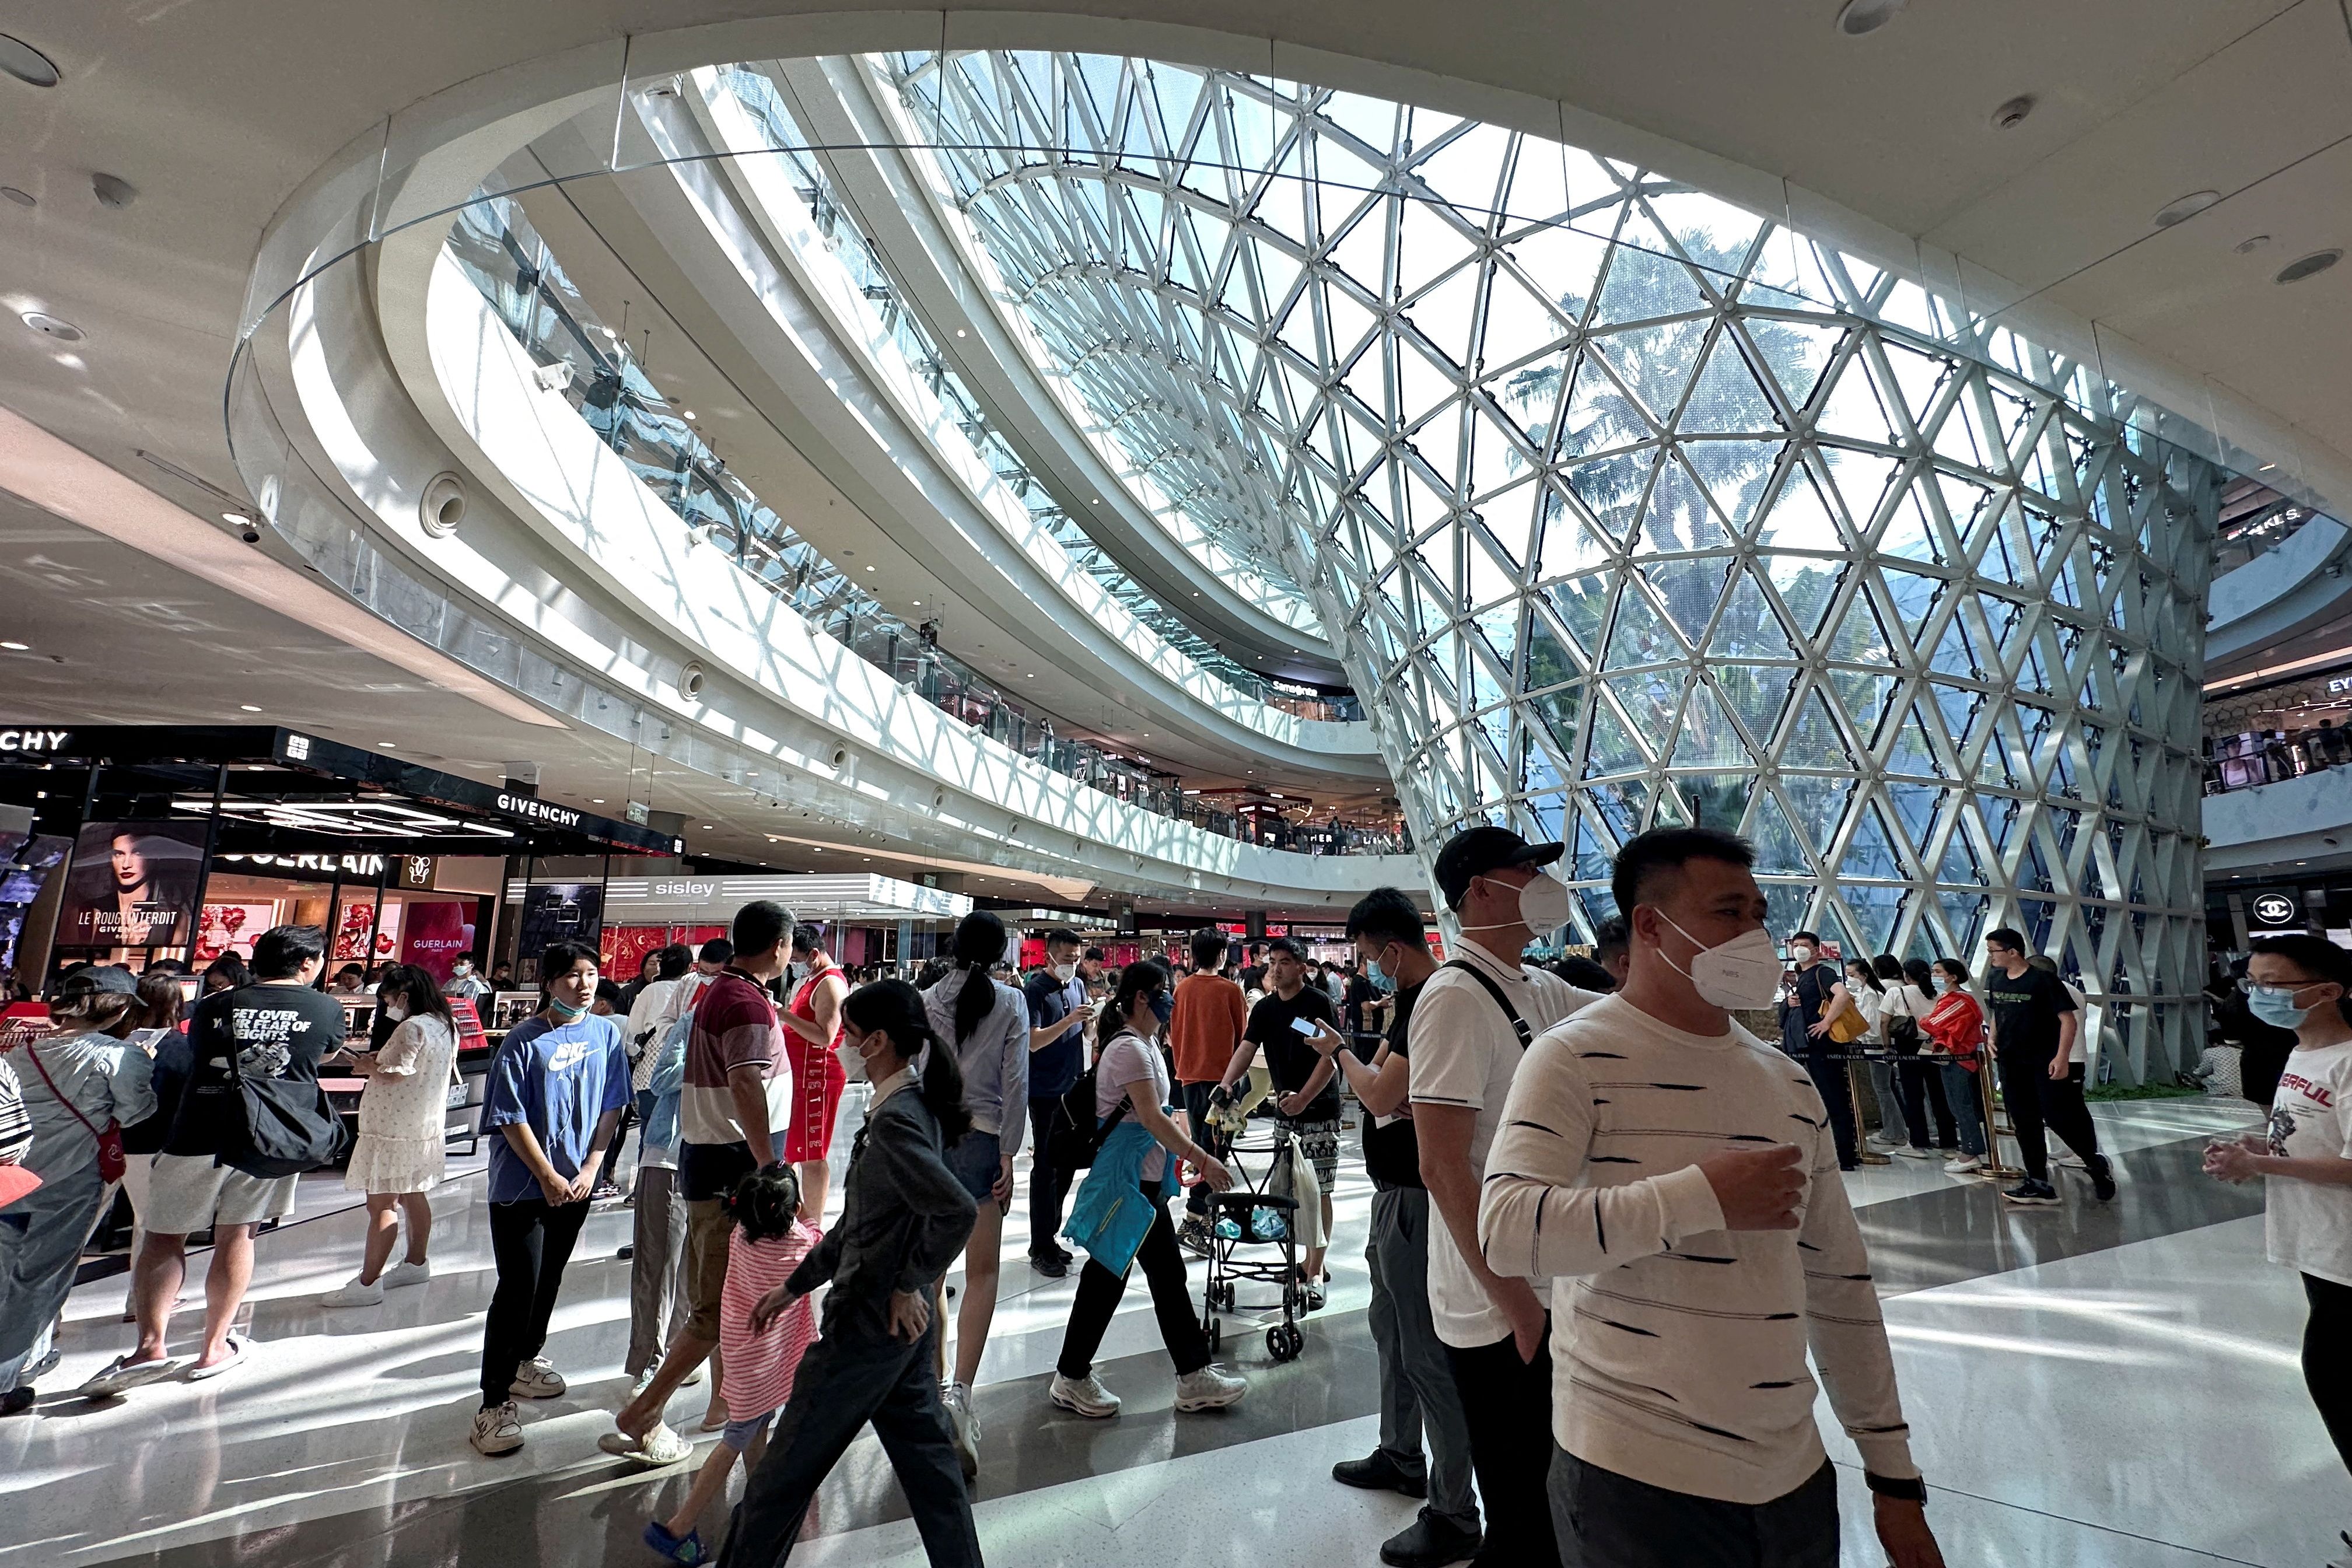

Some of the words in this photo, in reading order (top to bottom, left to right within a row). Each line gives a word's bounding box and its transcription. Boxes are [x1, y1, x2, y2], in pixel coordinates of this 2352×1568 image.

[2328, 677, 2352, 692] EY
[497, 794, 580, 827] GIVENCHY
[224, 855, 383, 875] ERLAIN
[655, 881, 715, 897] sisley
[78, 912, 92, 925] LE
[413, 940, 463, 949] GUERLAIN
[233, 1009, 258, 1020] GET
[258, 1010, 299, 1021] OVER
[253, 1020, 291, 1031] FEAR
[292, 1021, 312, 1032] OF
[233, 1029, 290, 1041] EIGHTS.
